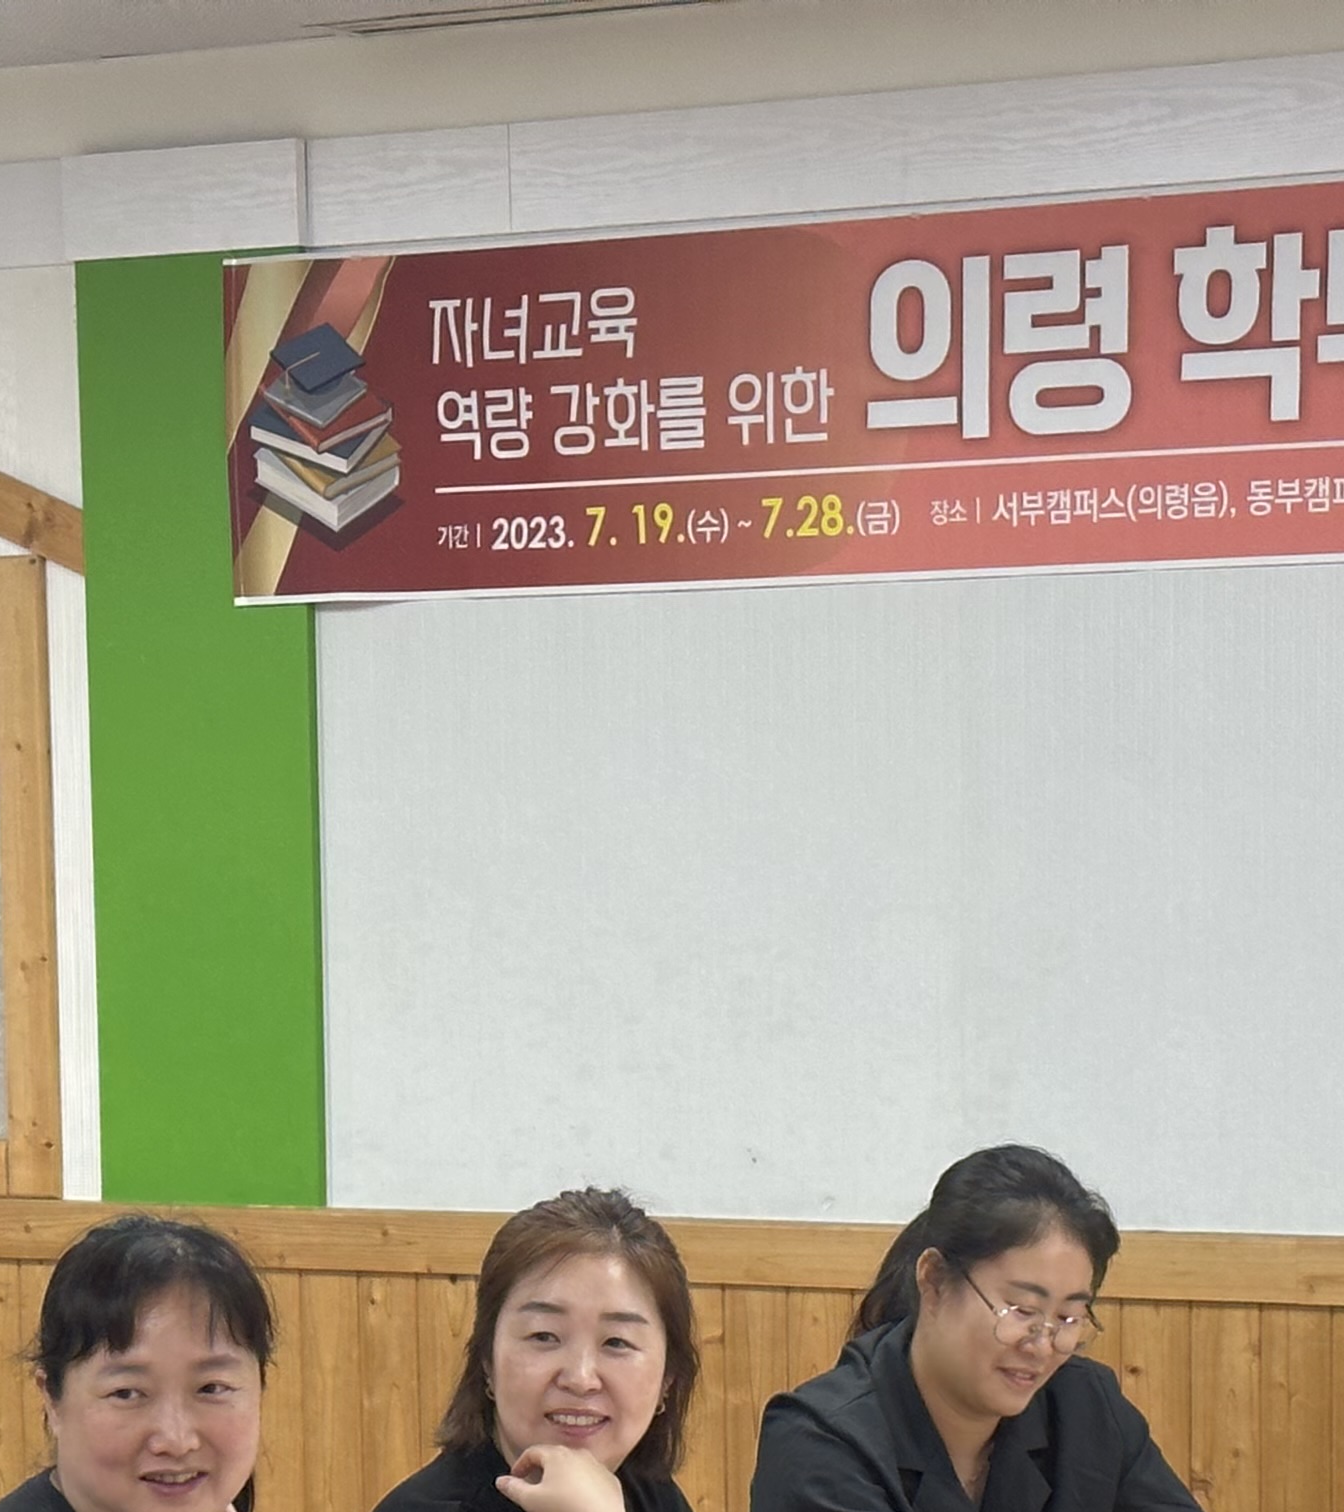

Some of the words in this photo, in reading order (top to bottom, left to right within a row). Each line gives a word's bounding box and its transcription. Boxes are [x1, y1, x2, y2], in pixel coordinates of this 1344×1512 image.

[428, 286, 638, 368] 자녀교육
[866, 245, 1132, 439] 의령
[436, 387, 533, 460] 역량
[550, 374, 706, 457] 강화를
[726, 365, 834, 446] 위한
[437, 526, 469, 549] 기간
[491, 516, 574, 550] 2023.
[929, 498, 968, 526] 장소
[991, 480, 1237, 528] 서부캠퍼스(의령읍),
